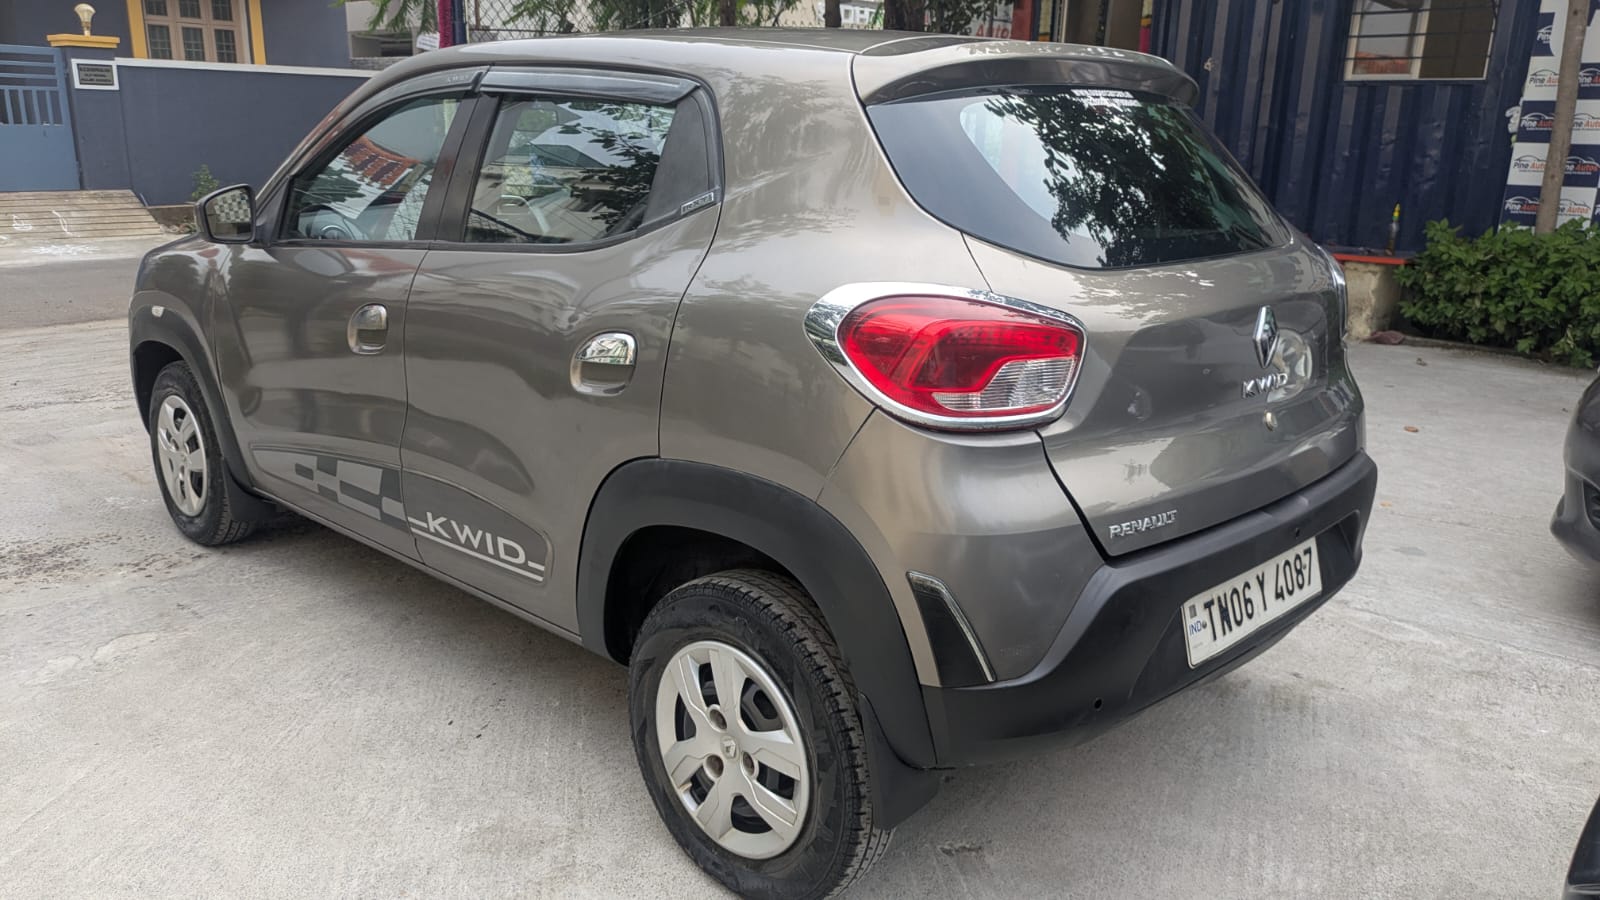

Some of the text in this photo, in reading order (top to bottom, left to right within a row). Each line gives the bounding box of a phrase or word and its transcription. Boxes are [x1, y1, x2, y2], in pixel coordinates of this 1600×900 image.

[1242, 372, 1289, 399] KWID
[426, 511, 526, 565] KWID
[1109, 509, 1178, 539] RENAULT
[1203, 546, 1312, 641] TN06 Y 4087
[1189, 620, 1202, 636] IND
